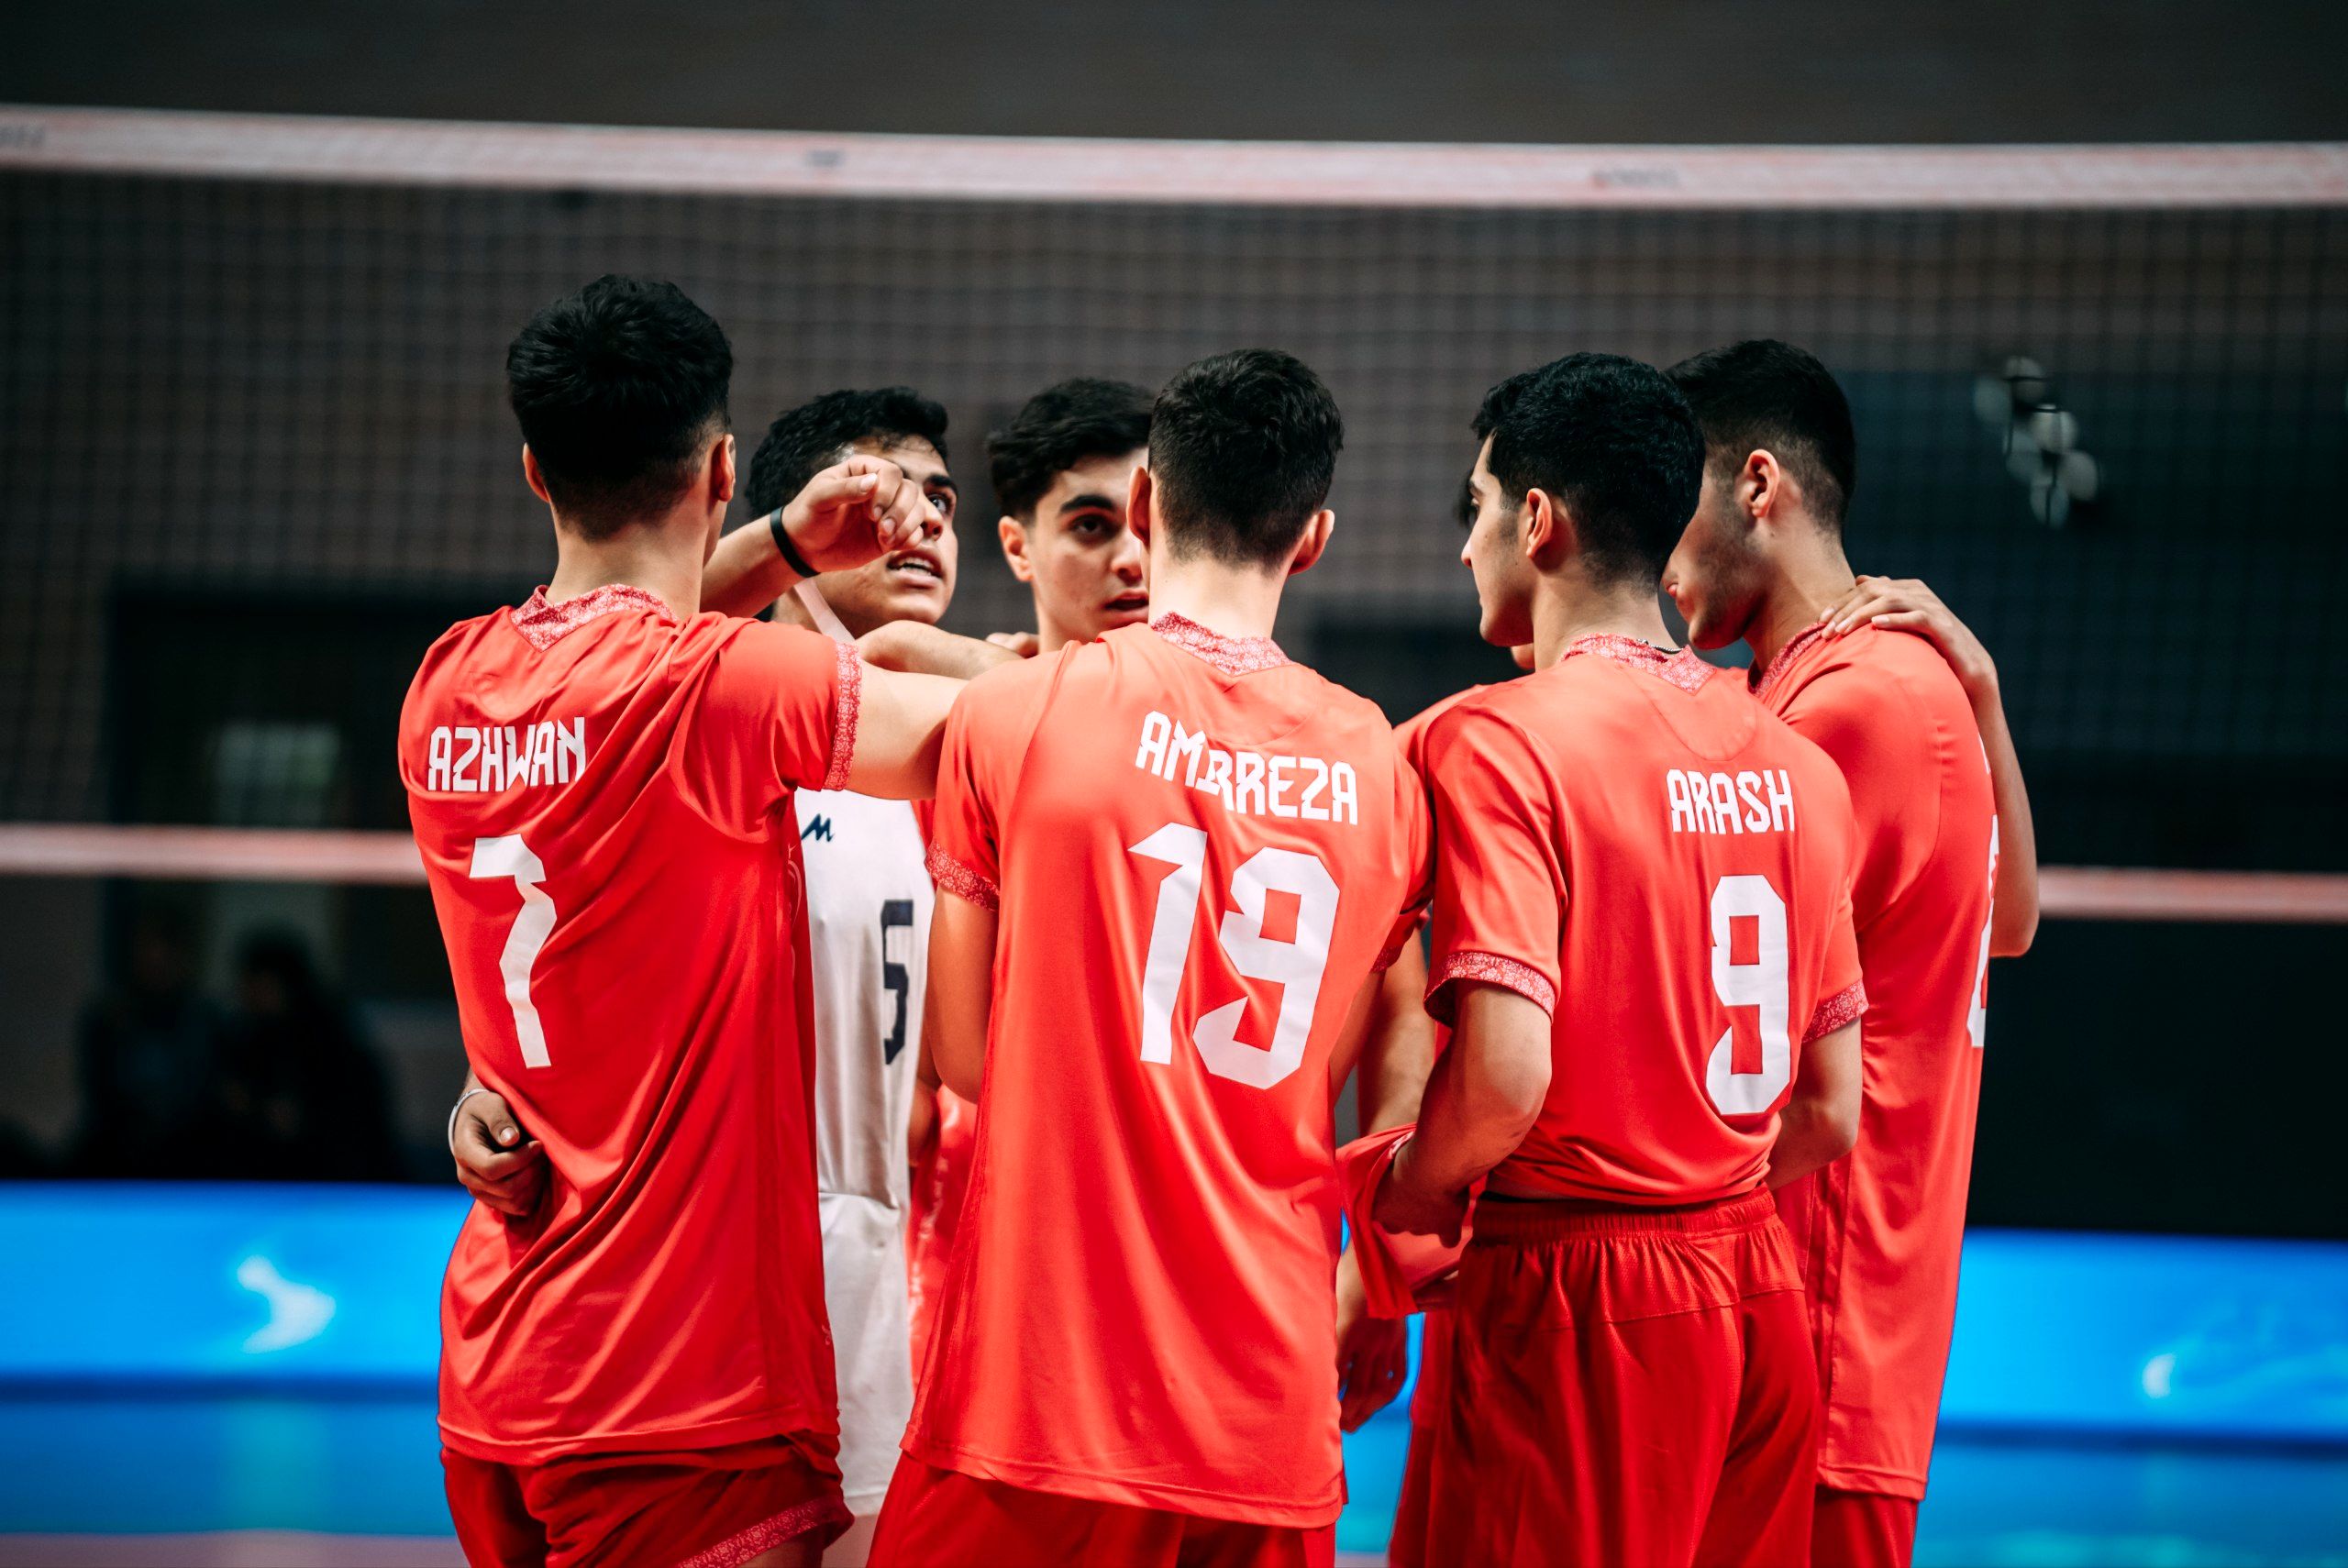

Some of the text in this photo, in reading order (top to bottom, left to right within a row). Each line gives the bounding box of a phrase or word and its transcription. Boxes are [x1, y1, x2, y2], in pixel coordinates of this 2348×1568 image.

[427, 716, 586, 792] AZHWAN
[1667, 768, 1794, 835] ARASH
[469, 834, 557, 1069] 7
[880, 899, 914, 1065] 5
[1127, 822, 1341, 1090] 19
[1705, 874, 1791, 1116] 9
